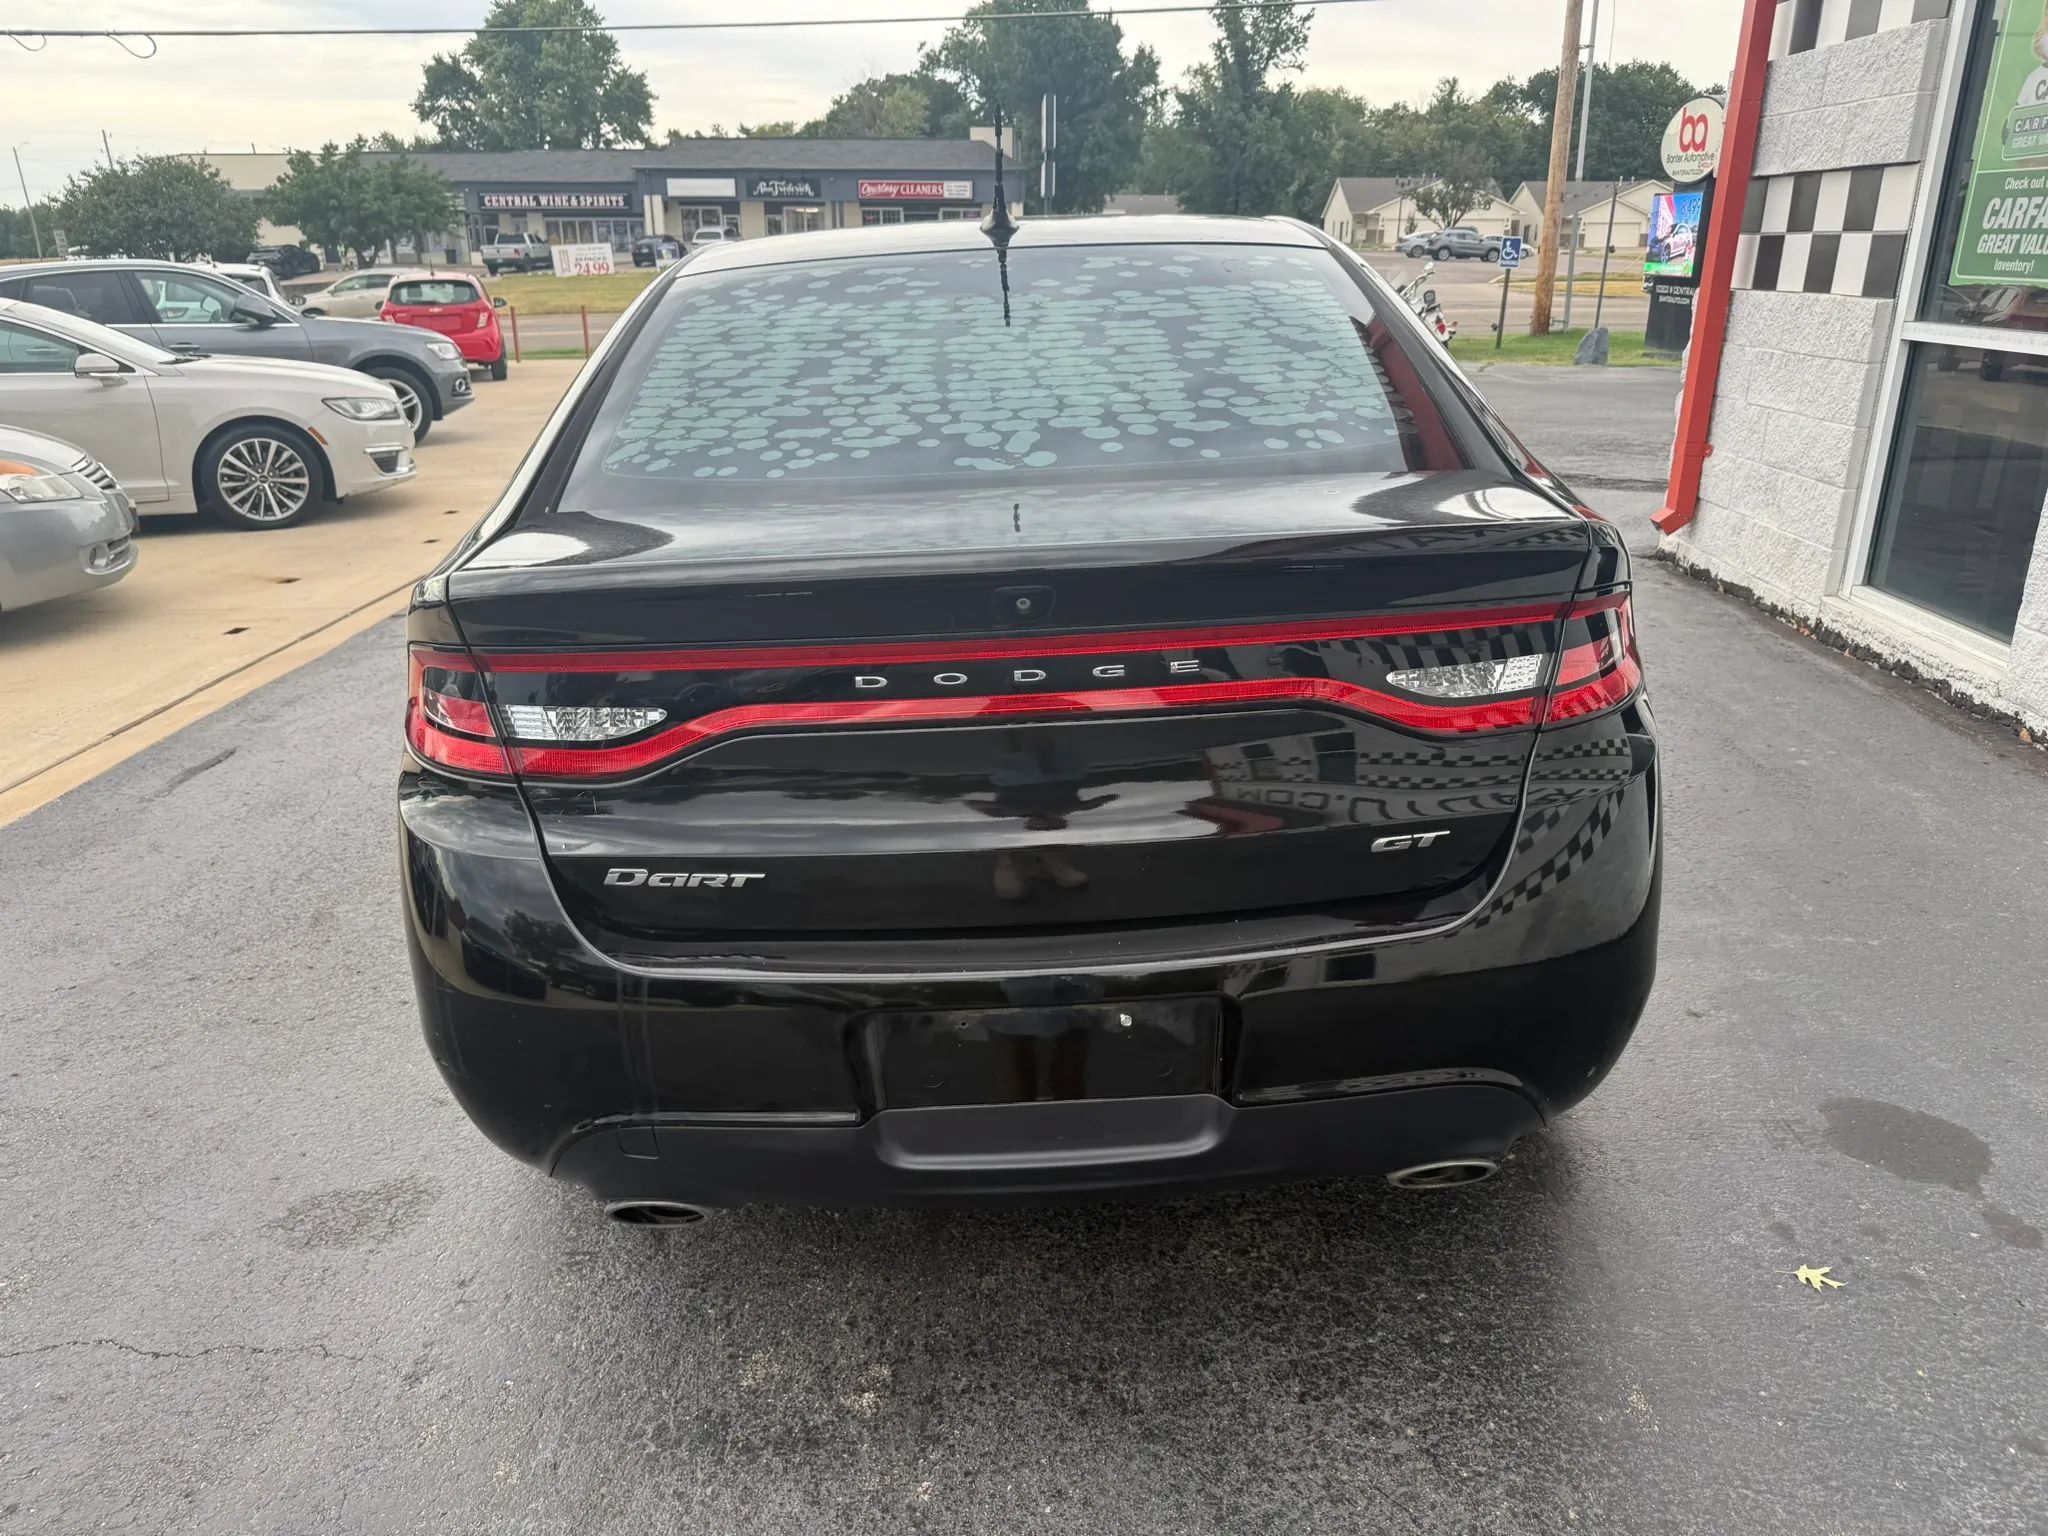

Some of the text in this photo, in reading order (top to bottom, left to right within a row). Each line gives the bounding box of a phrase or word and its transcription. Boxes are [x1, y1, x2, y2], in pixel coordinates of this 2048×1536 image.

[861, 182, 900, 198] Courtesy
[900, 182, 945, 196] CLEANERS
[2004, 176, 2029, 190] Check
[2030, 175, 2045, 189] out
[484, 194, 537, 208] CENTRAL
[1977, 233, 2021, 254] GREAT
[574, 261, 609, 276] 24.99
[1993, 258, 2035, 274] Inventory!
[855, 659, 1200, 689] DODGE
[1371, 830, 1451, 853] GT
